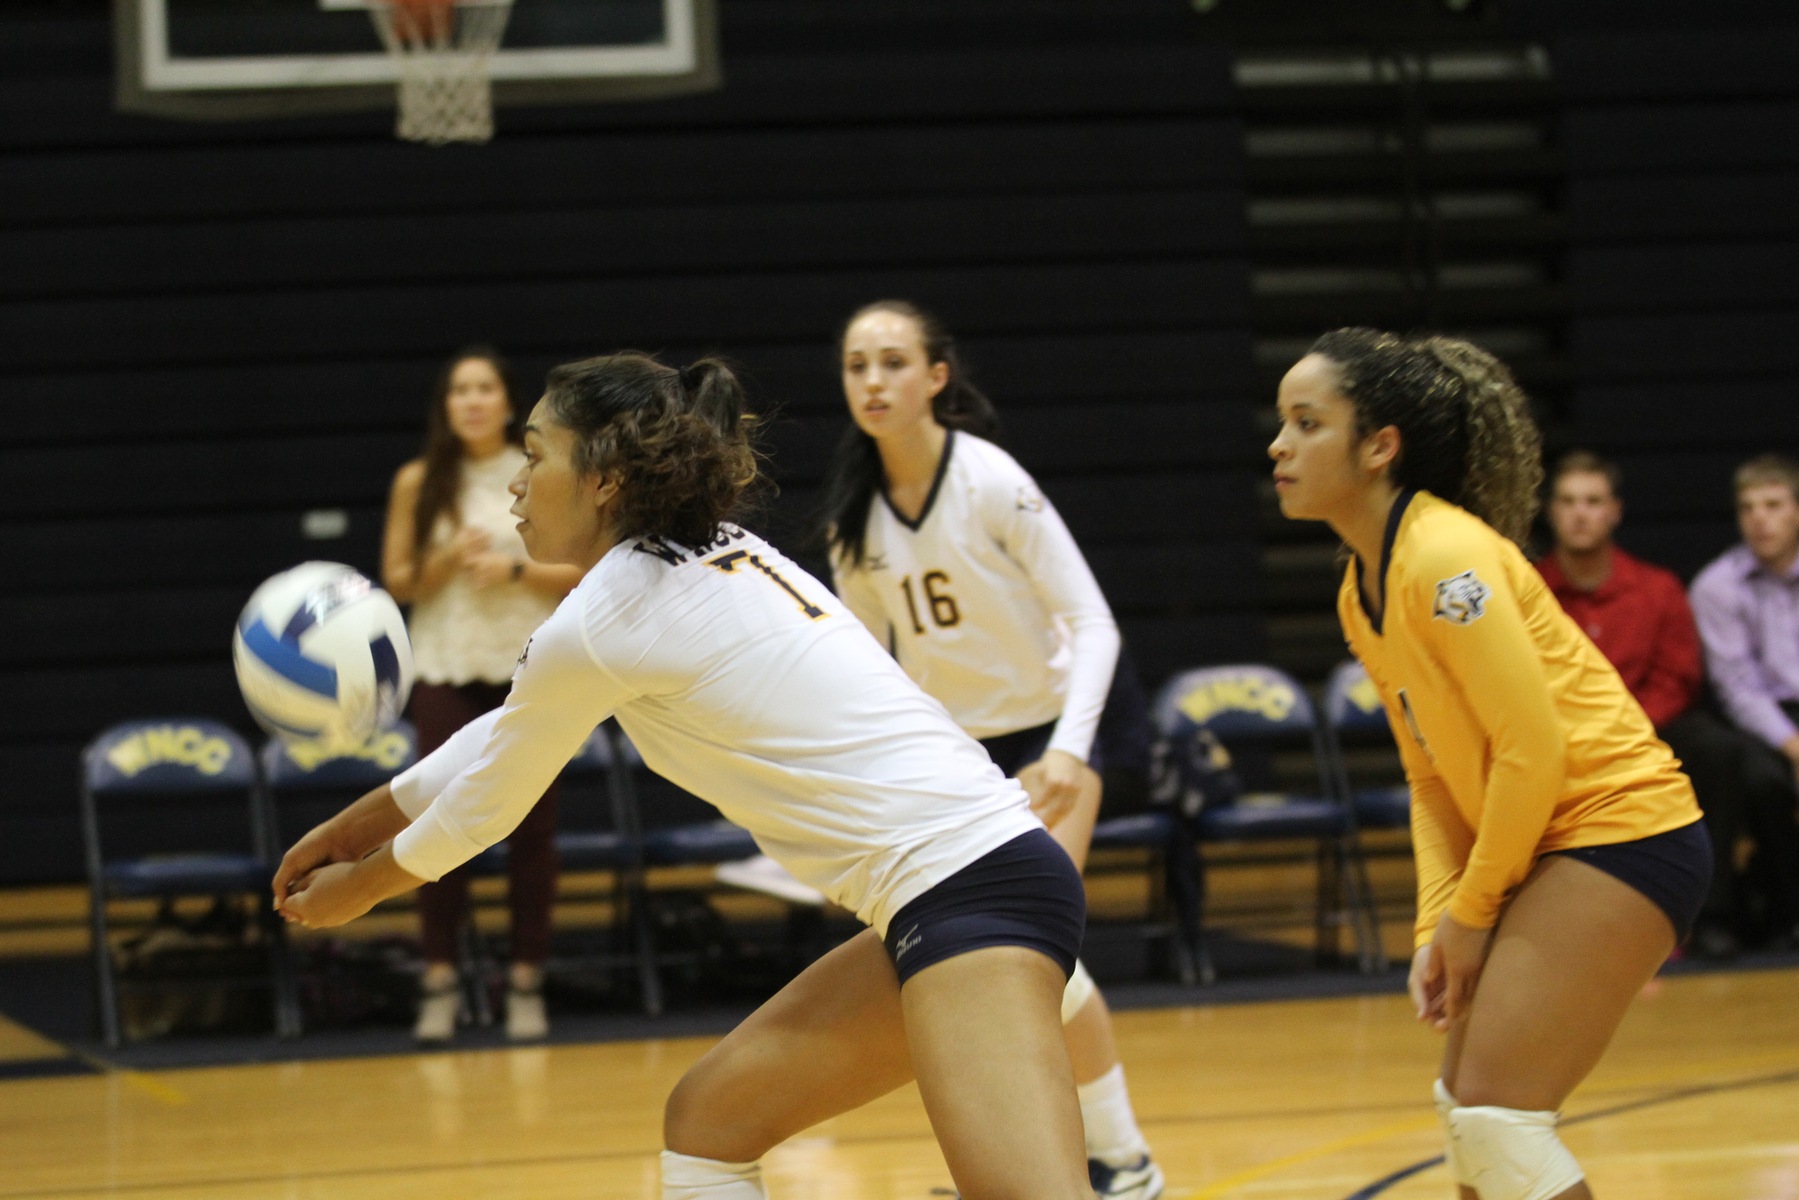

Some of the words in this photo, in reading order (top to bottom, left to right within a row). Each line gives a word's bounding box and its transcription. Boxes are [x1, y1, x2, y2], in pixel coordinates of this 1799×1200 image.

[703, 549, 832, 622] 7
[899, 570, 962, 635] 16
[107, 726, 232, 778] WNCC
